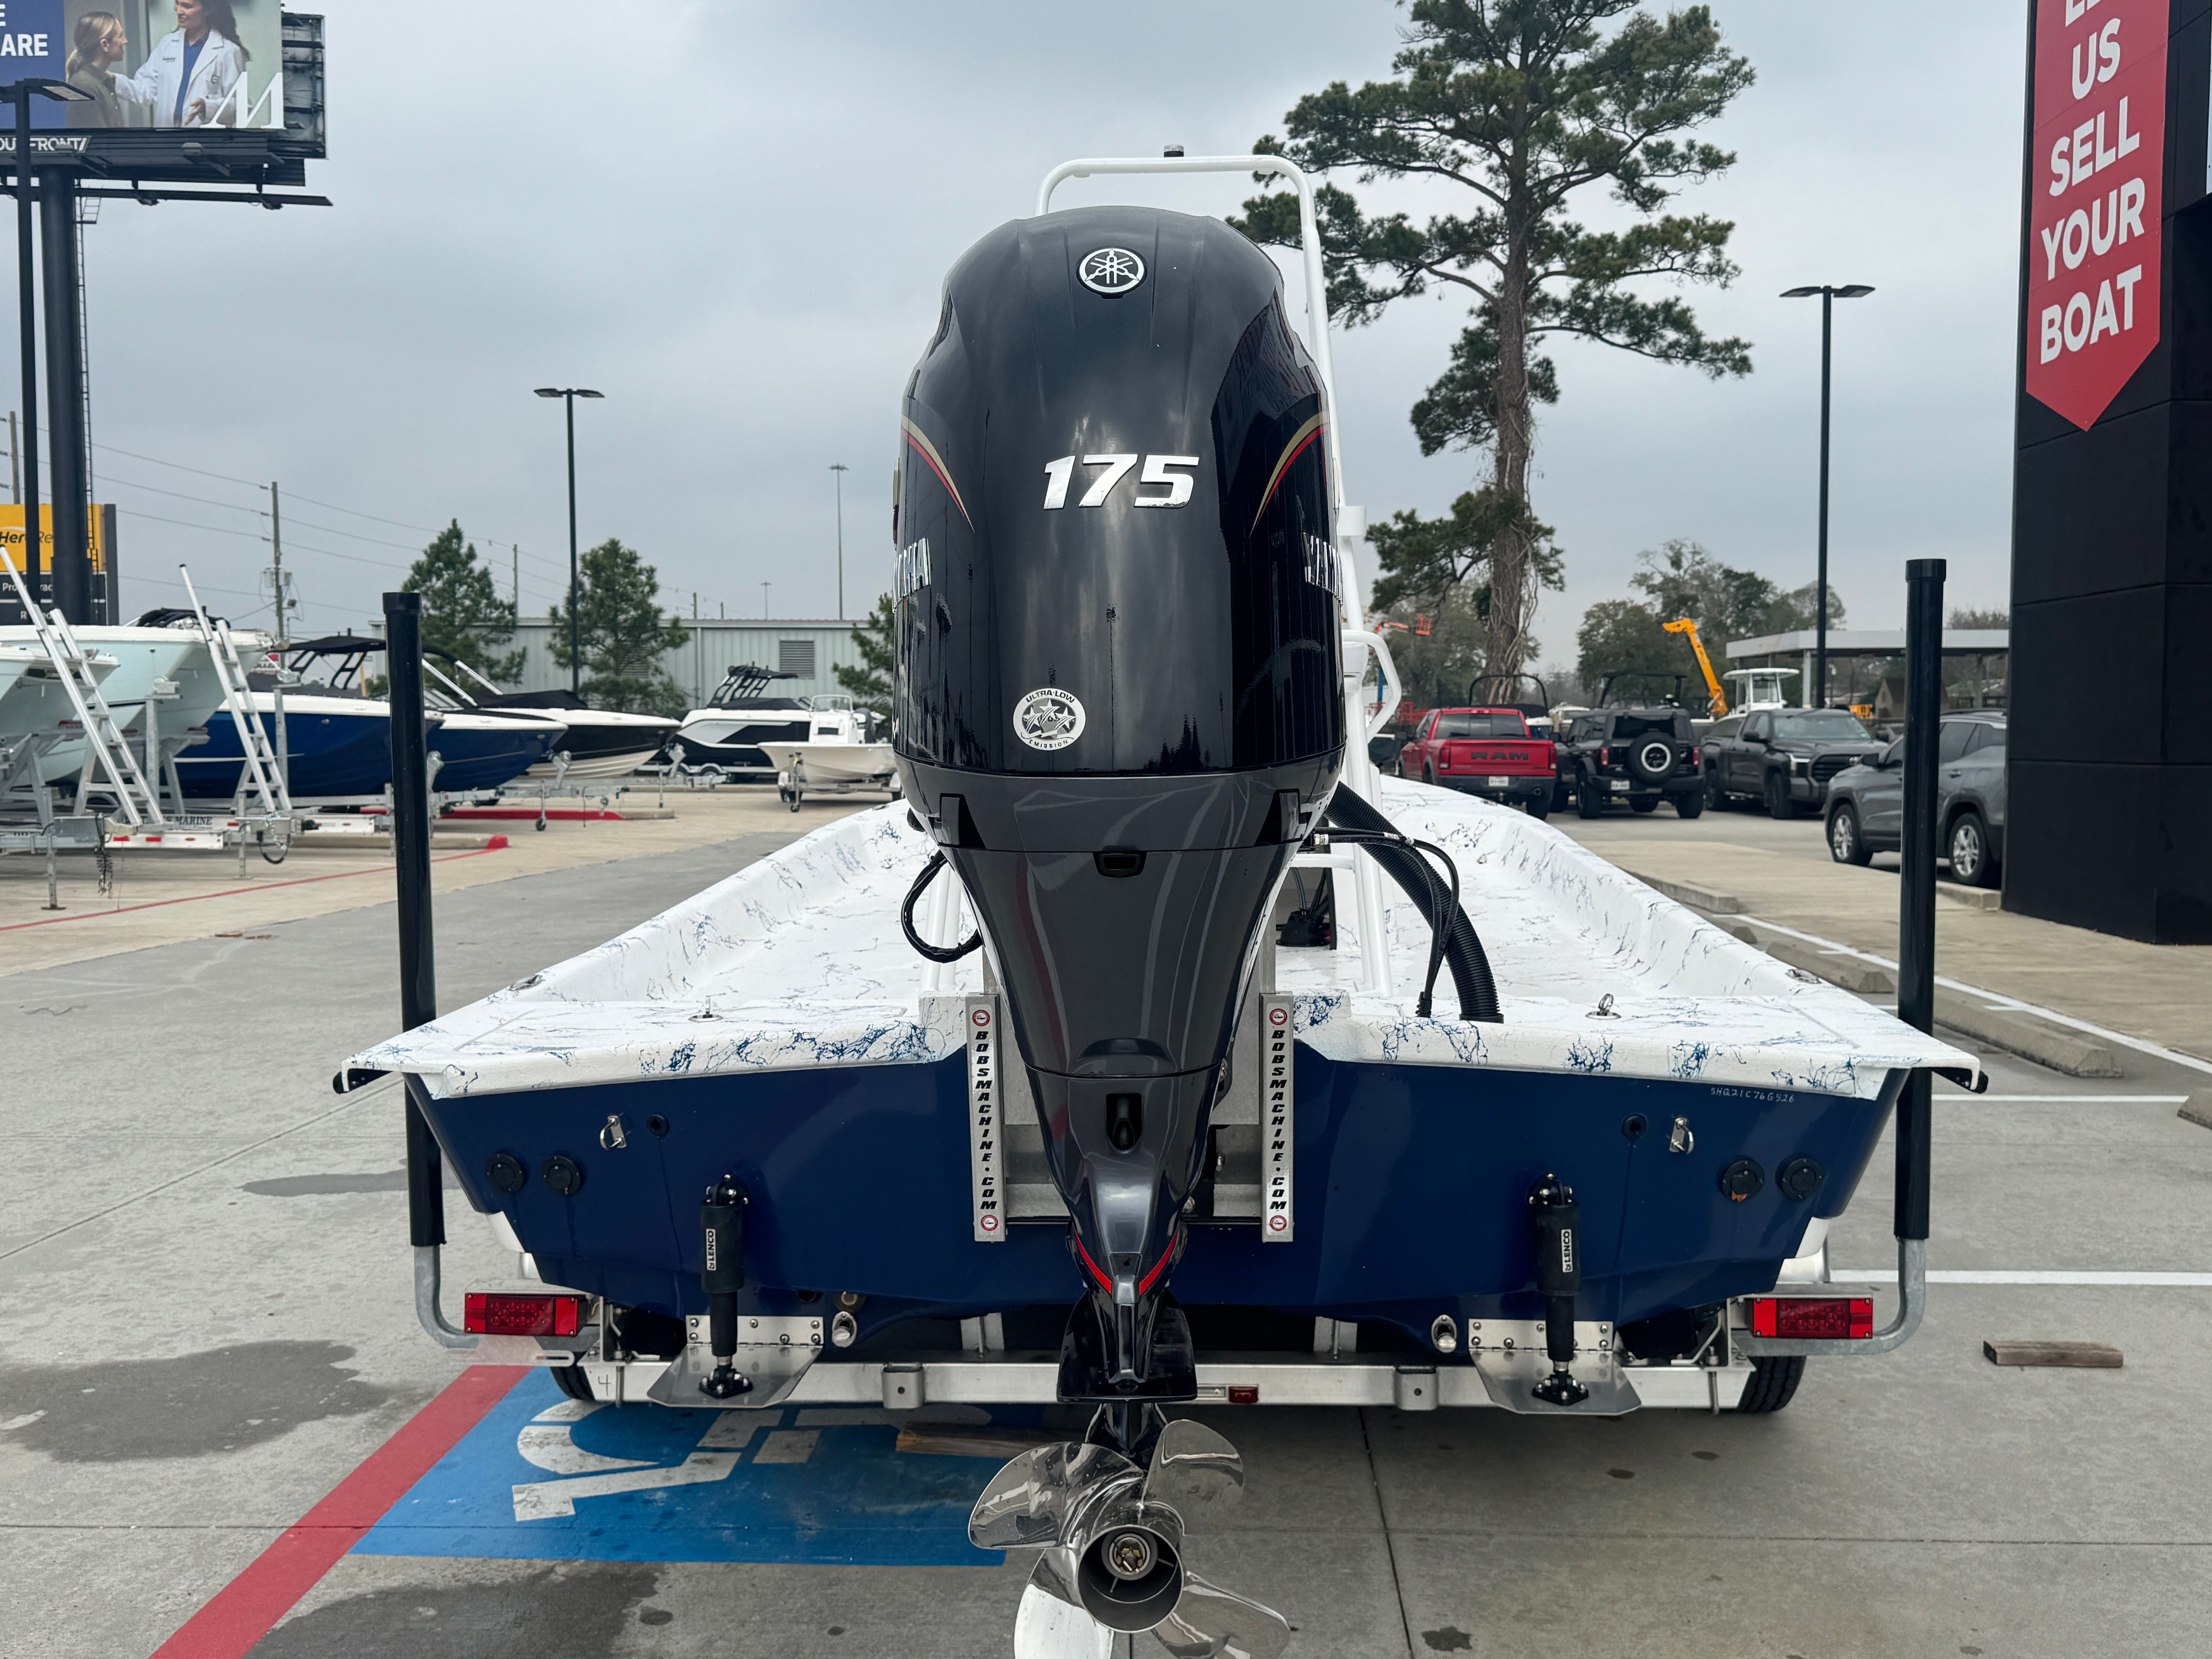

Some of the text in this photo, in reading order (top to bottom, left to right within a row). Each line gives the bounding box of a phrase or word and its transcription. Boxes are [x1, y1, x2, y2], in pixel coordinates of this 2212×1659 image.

[2072, 18, 2121, 100] US
[2049, 96, 2140, 196] SELL
[2041, 177, 2145, 281] YOUR
[2040, 264, 2142, 364] BOAT
[1044, 454, 1199, 509] 175
[1472, 752, 1528, 760] RAM
[176, 816, 213, 825] MARINE
[975, 1031, 997, 1209] BOBSMACHINE.COM
[1269, 1030, 1287, 1209] BOBSMACHINE.COM
